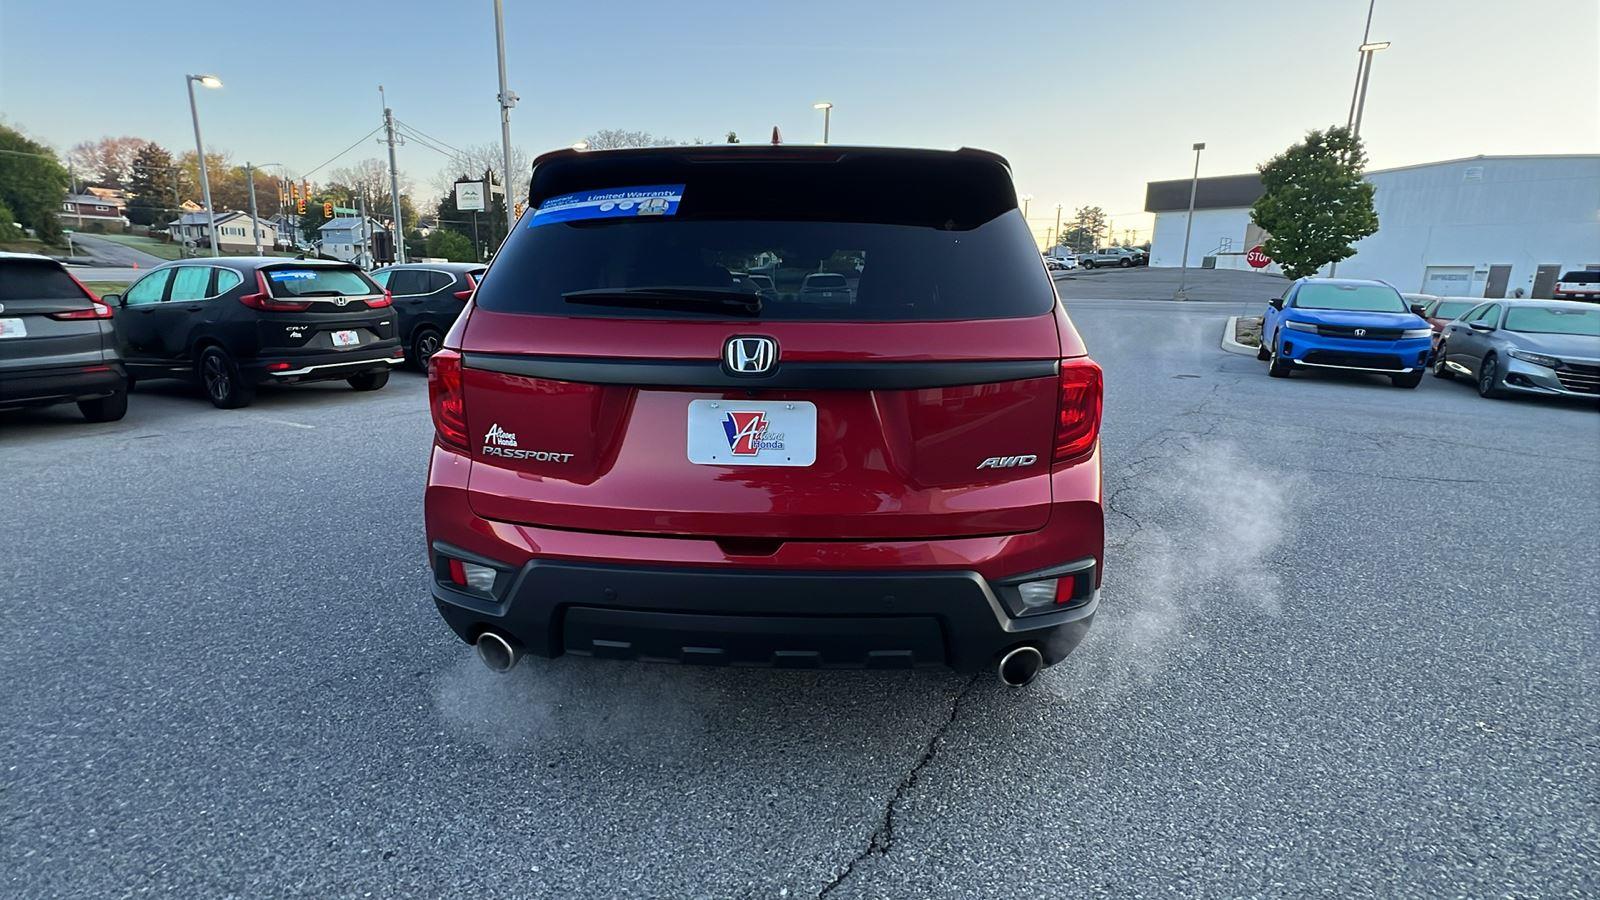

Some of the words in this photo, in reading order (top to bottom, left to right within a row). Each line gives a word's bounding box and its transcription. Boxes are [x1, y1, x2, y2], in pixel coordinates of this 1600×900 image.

[587, 192, 625, 201] Limited
[626, 190, 676, 199] Warranty
[753, 440, 783, 449] Honda
[482, 445, 575, 463] PASSPORT
[976, 454, 1037, 469] AWD
